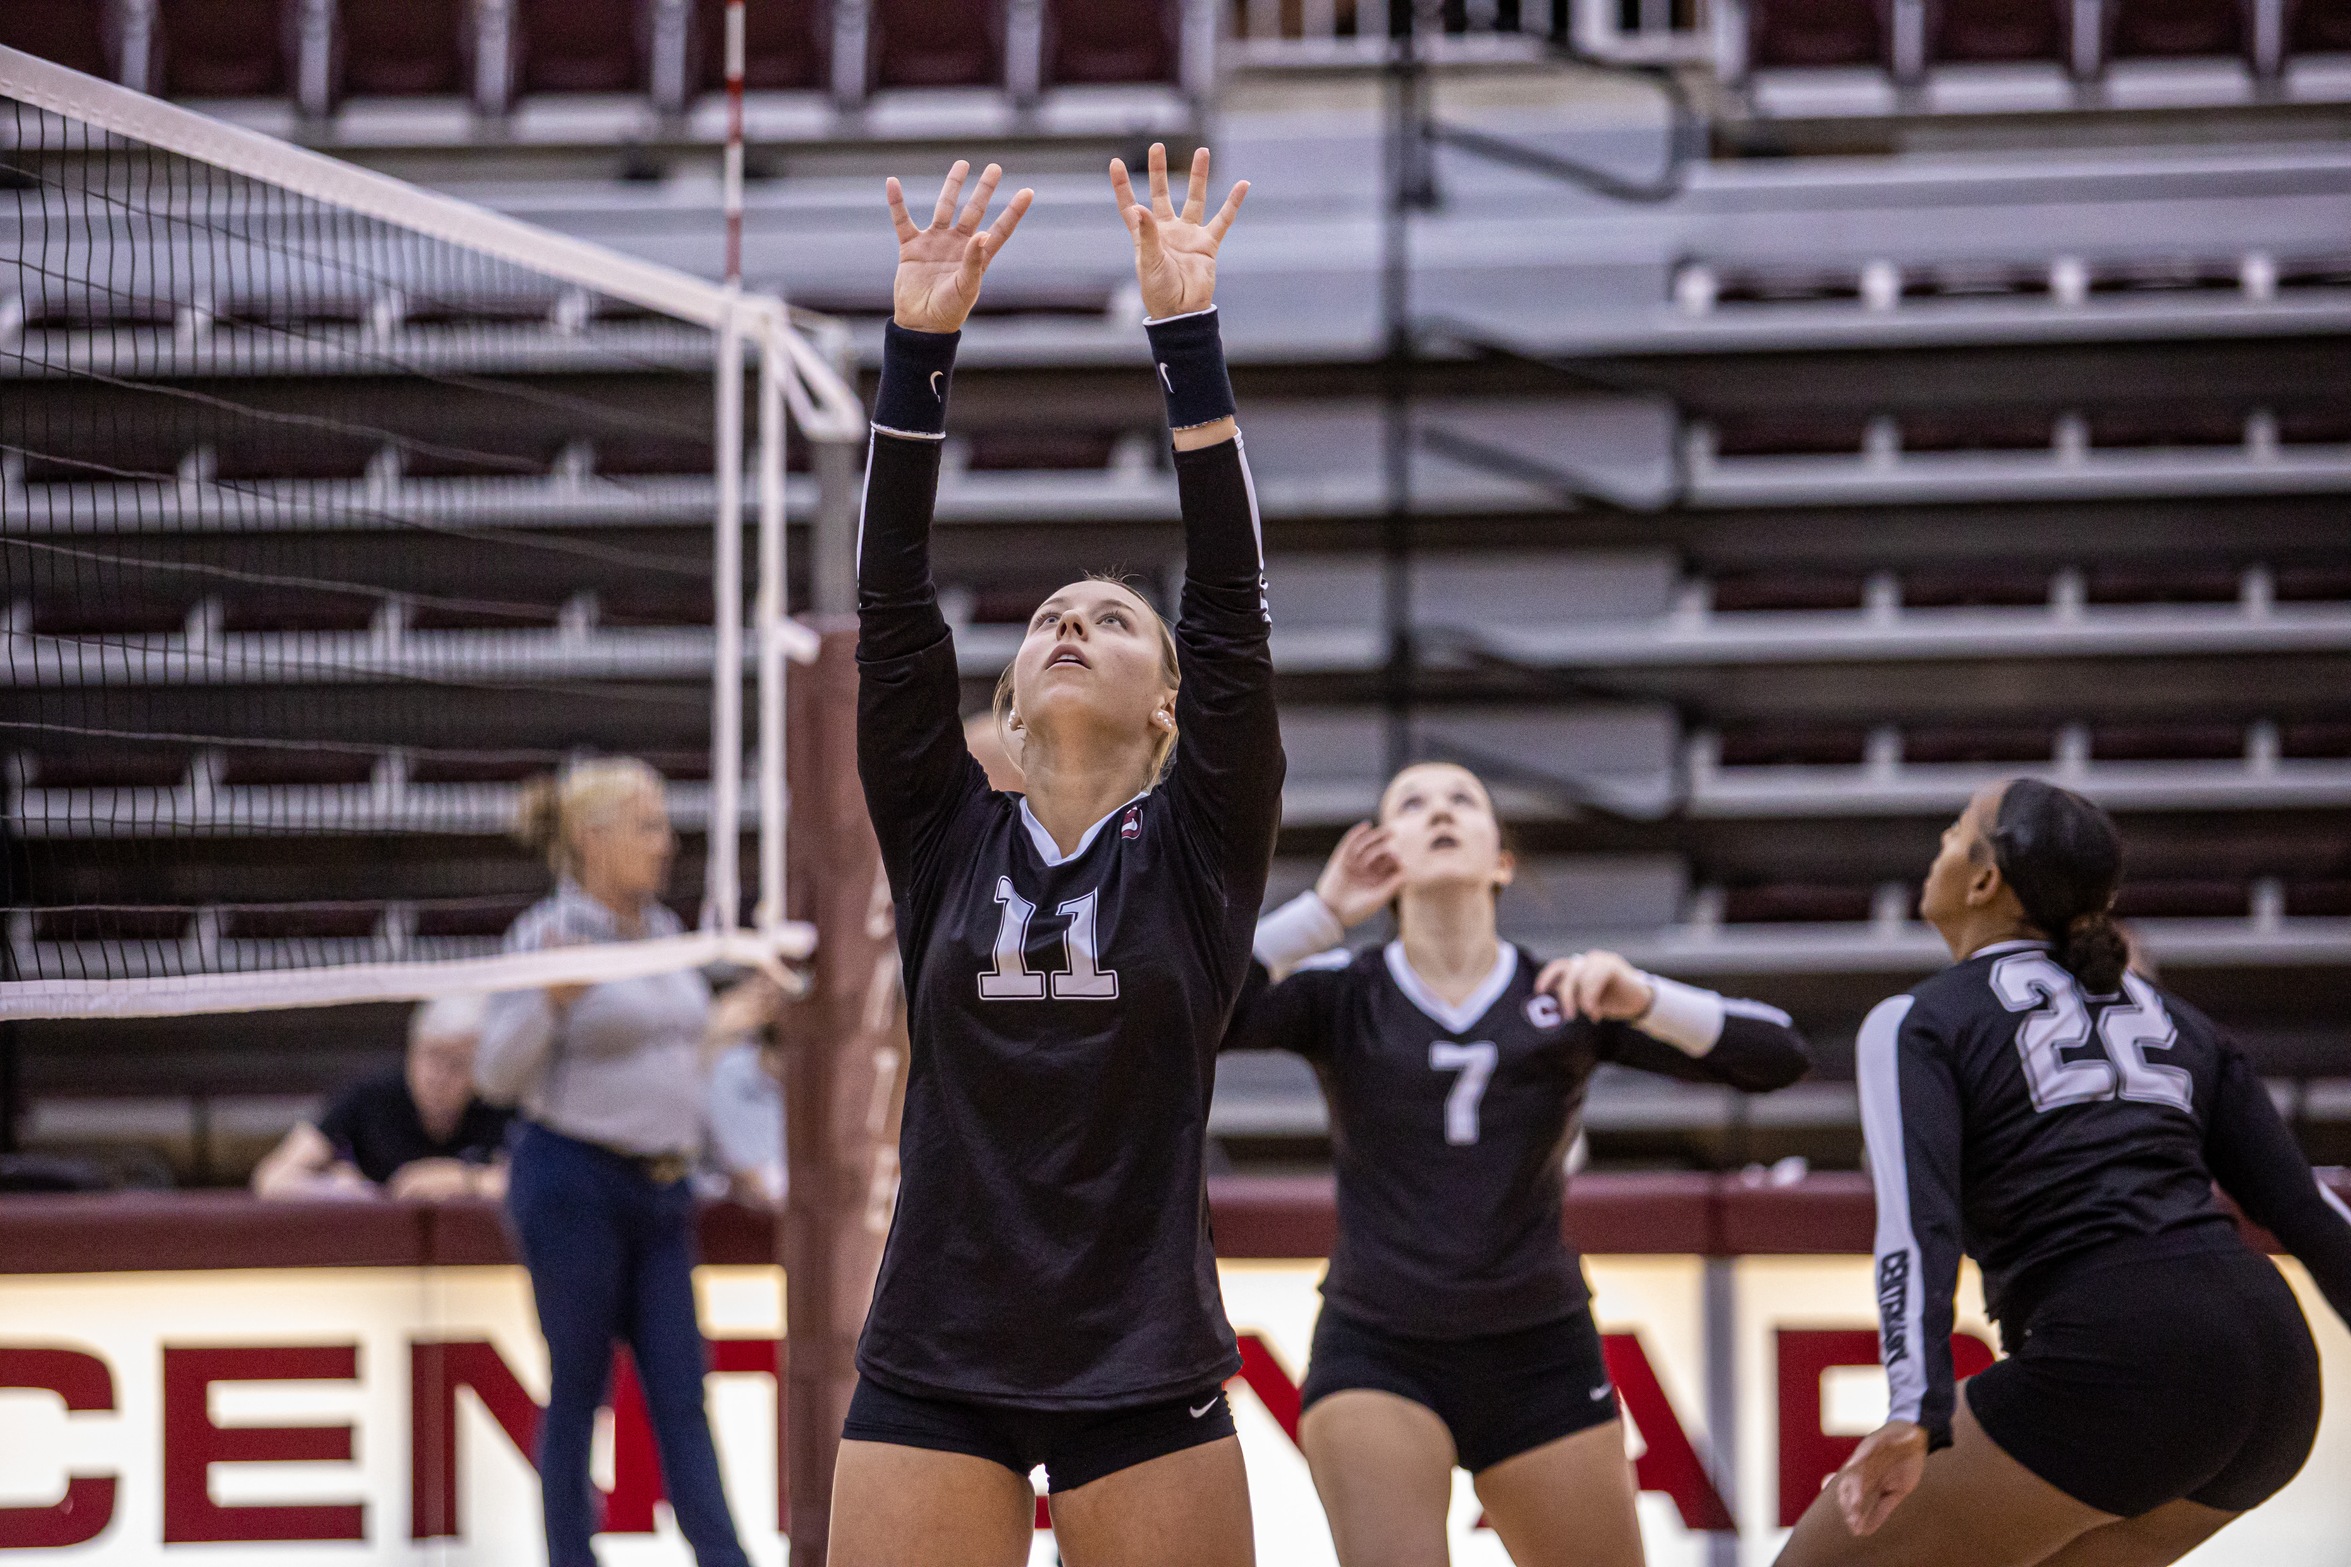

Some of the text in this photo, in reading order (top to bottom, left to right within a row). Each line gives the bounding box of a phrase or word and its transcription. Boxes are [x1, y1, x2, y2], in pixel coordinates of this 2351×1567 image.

[977, 875, 1119, 1000] 11
[1428, 1040, 1499, 1146] 7
[1989, 949, 2193, 1114] 22
